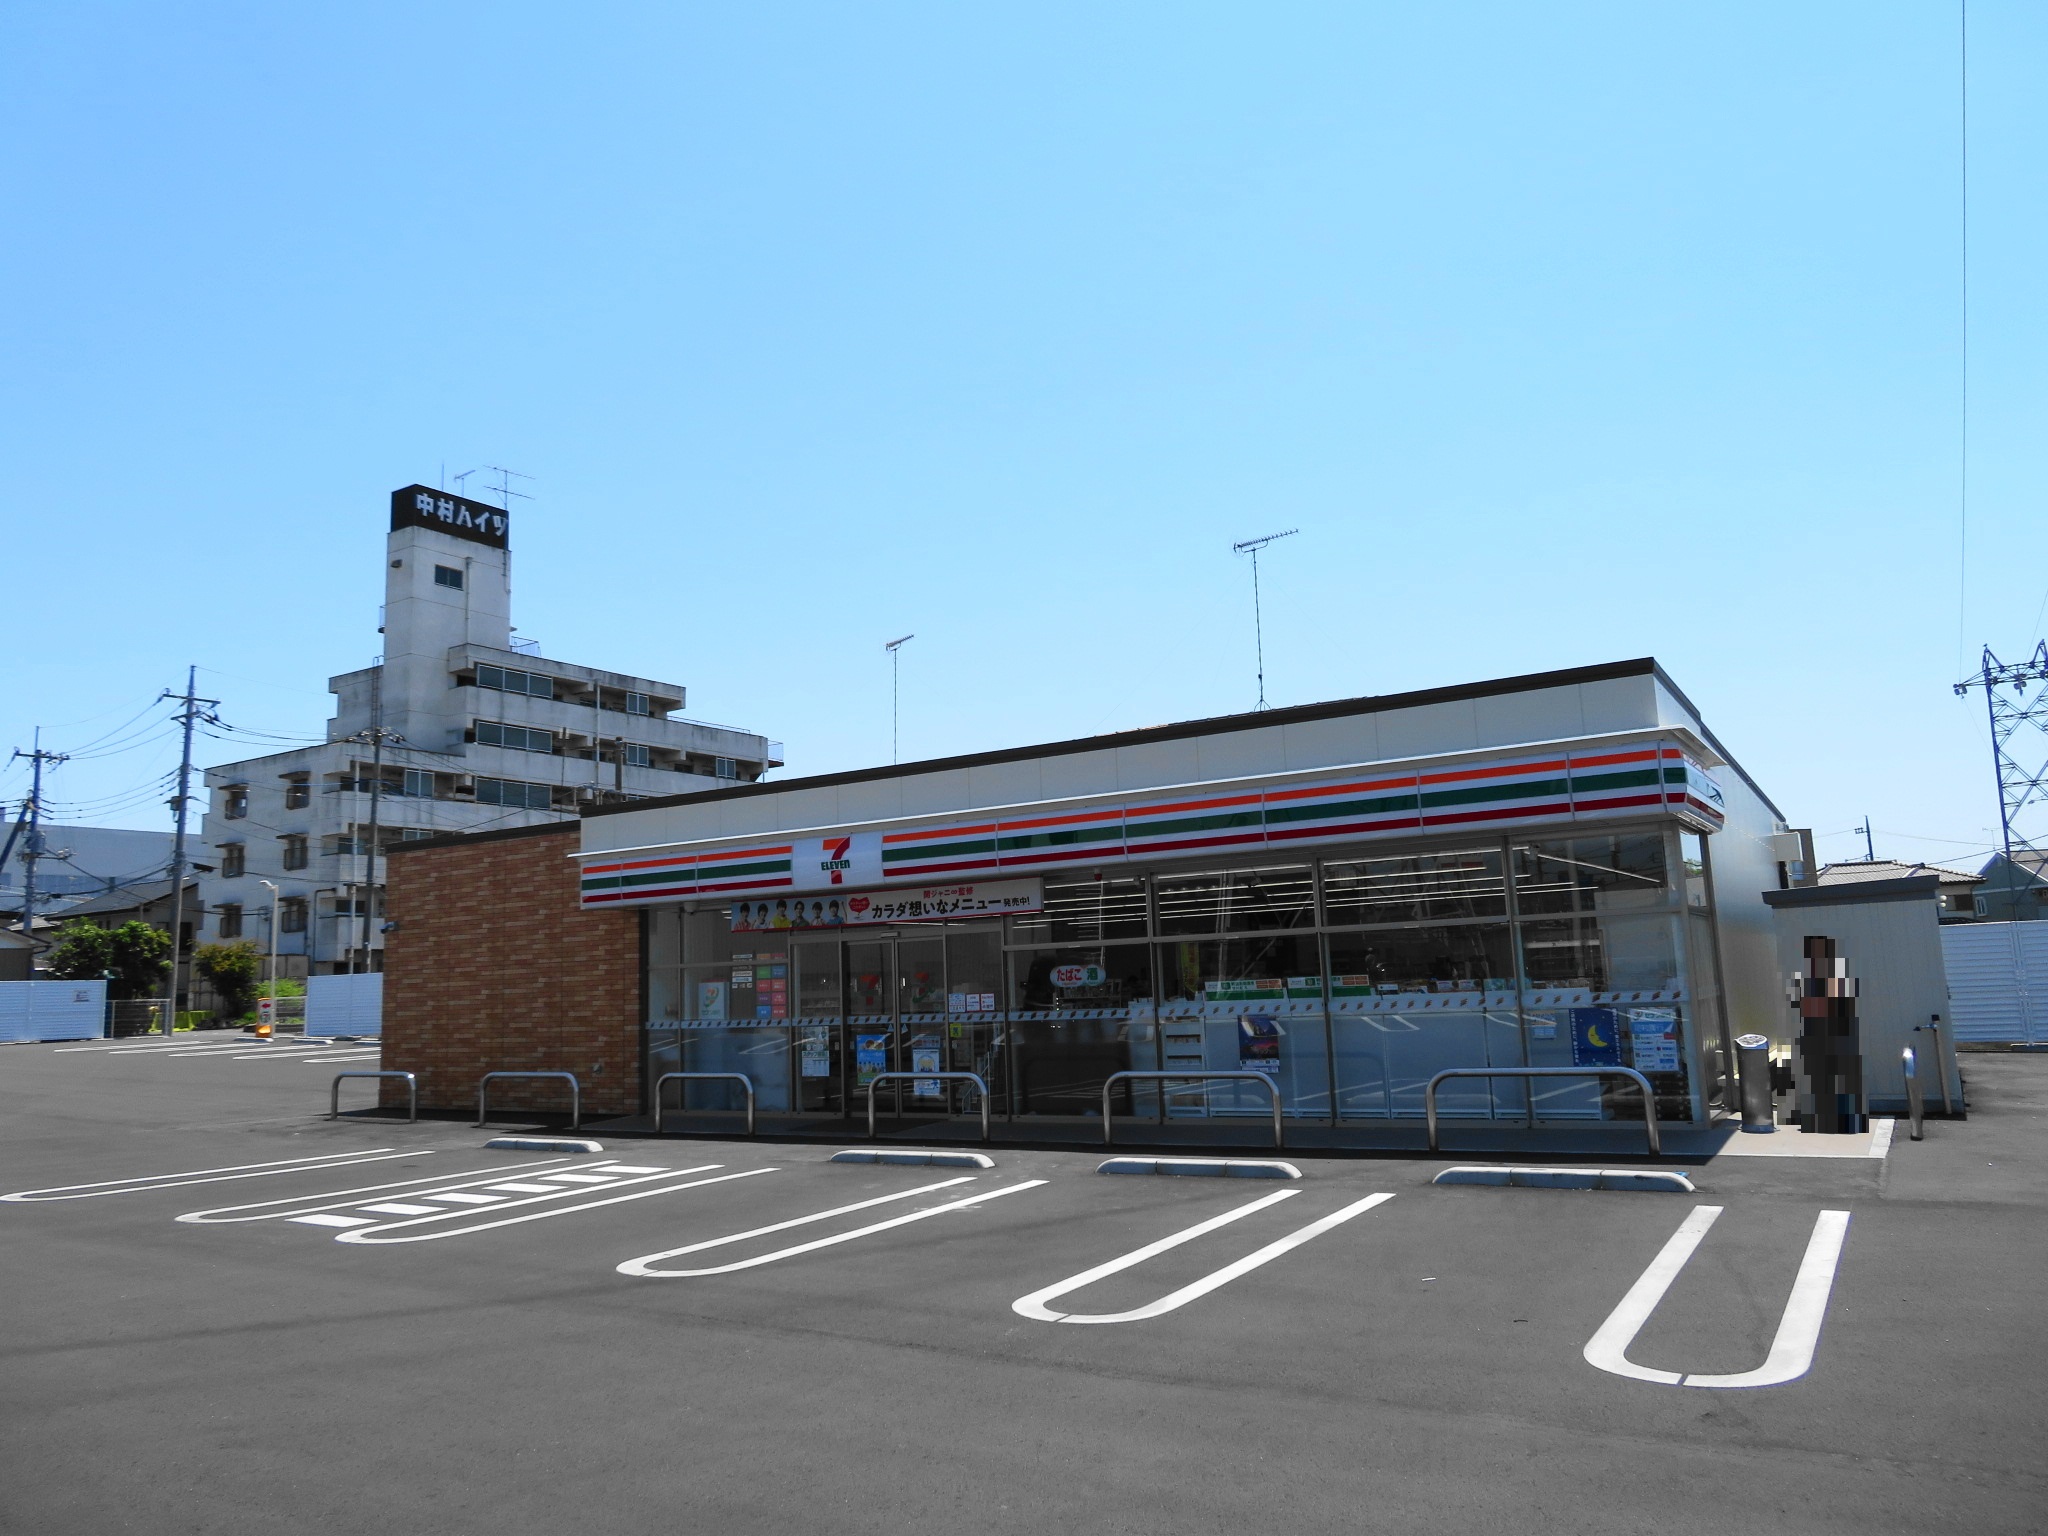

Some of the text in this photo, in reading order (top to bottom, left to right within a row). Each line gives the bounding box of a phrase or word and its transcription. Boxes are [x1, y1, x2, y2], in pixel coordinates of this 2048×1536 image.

[416, 493, 507, 536] 中村ハイツ
[823, 837, 850, 884] 7
[923, 886, 974, 899] 関ジャニ∞監修
[872, 898, 1002, 919] カラダ想いなメニュー
[1057, 967, 1098, 981] たばこ 酒
